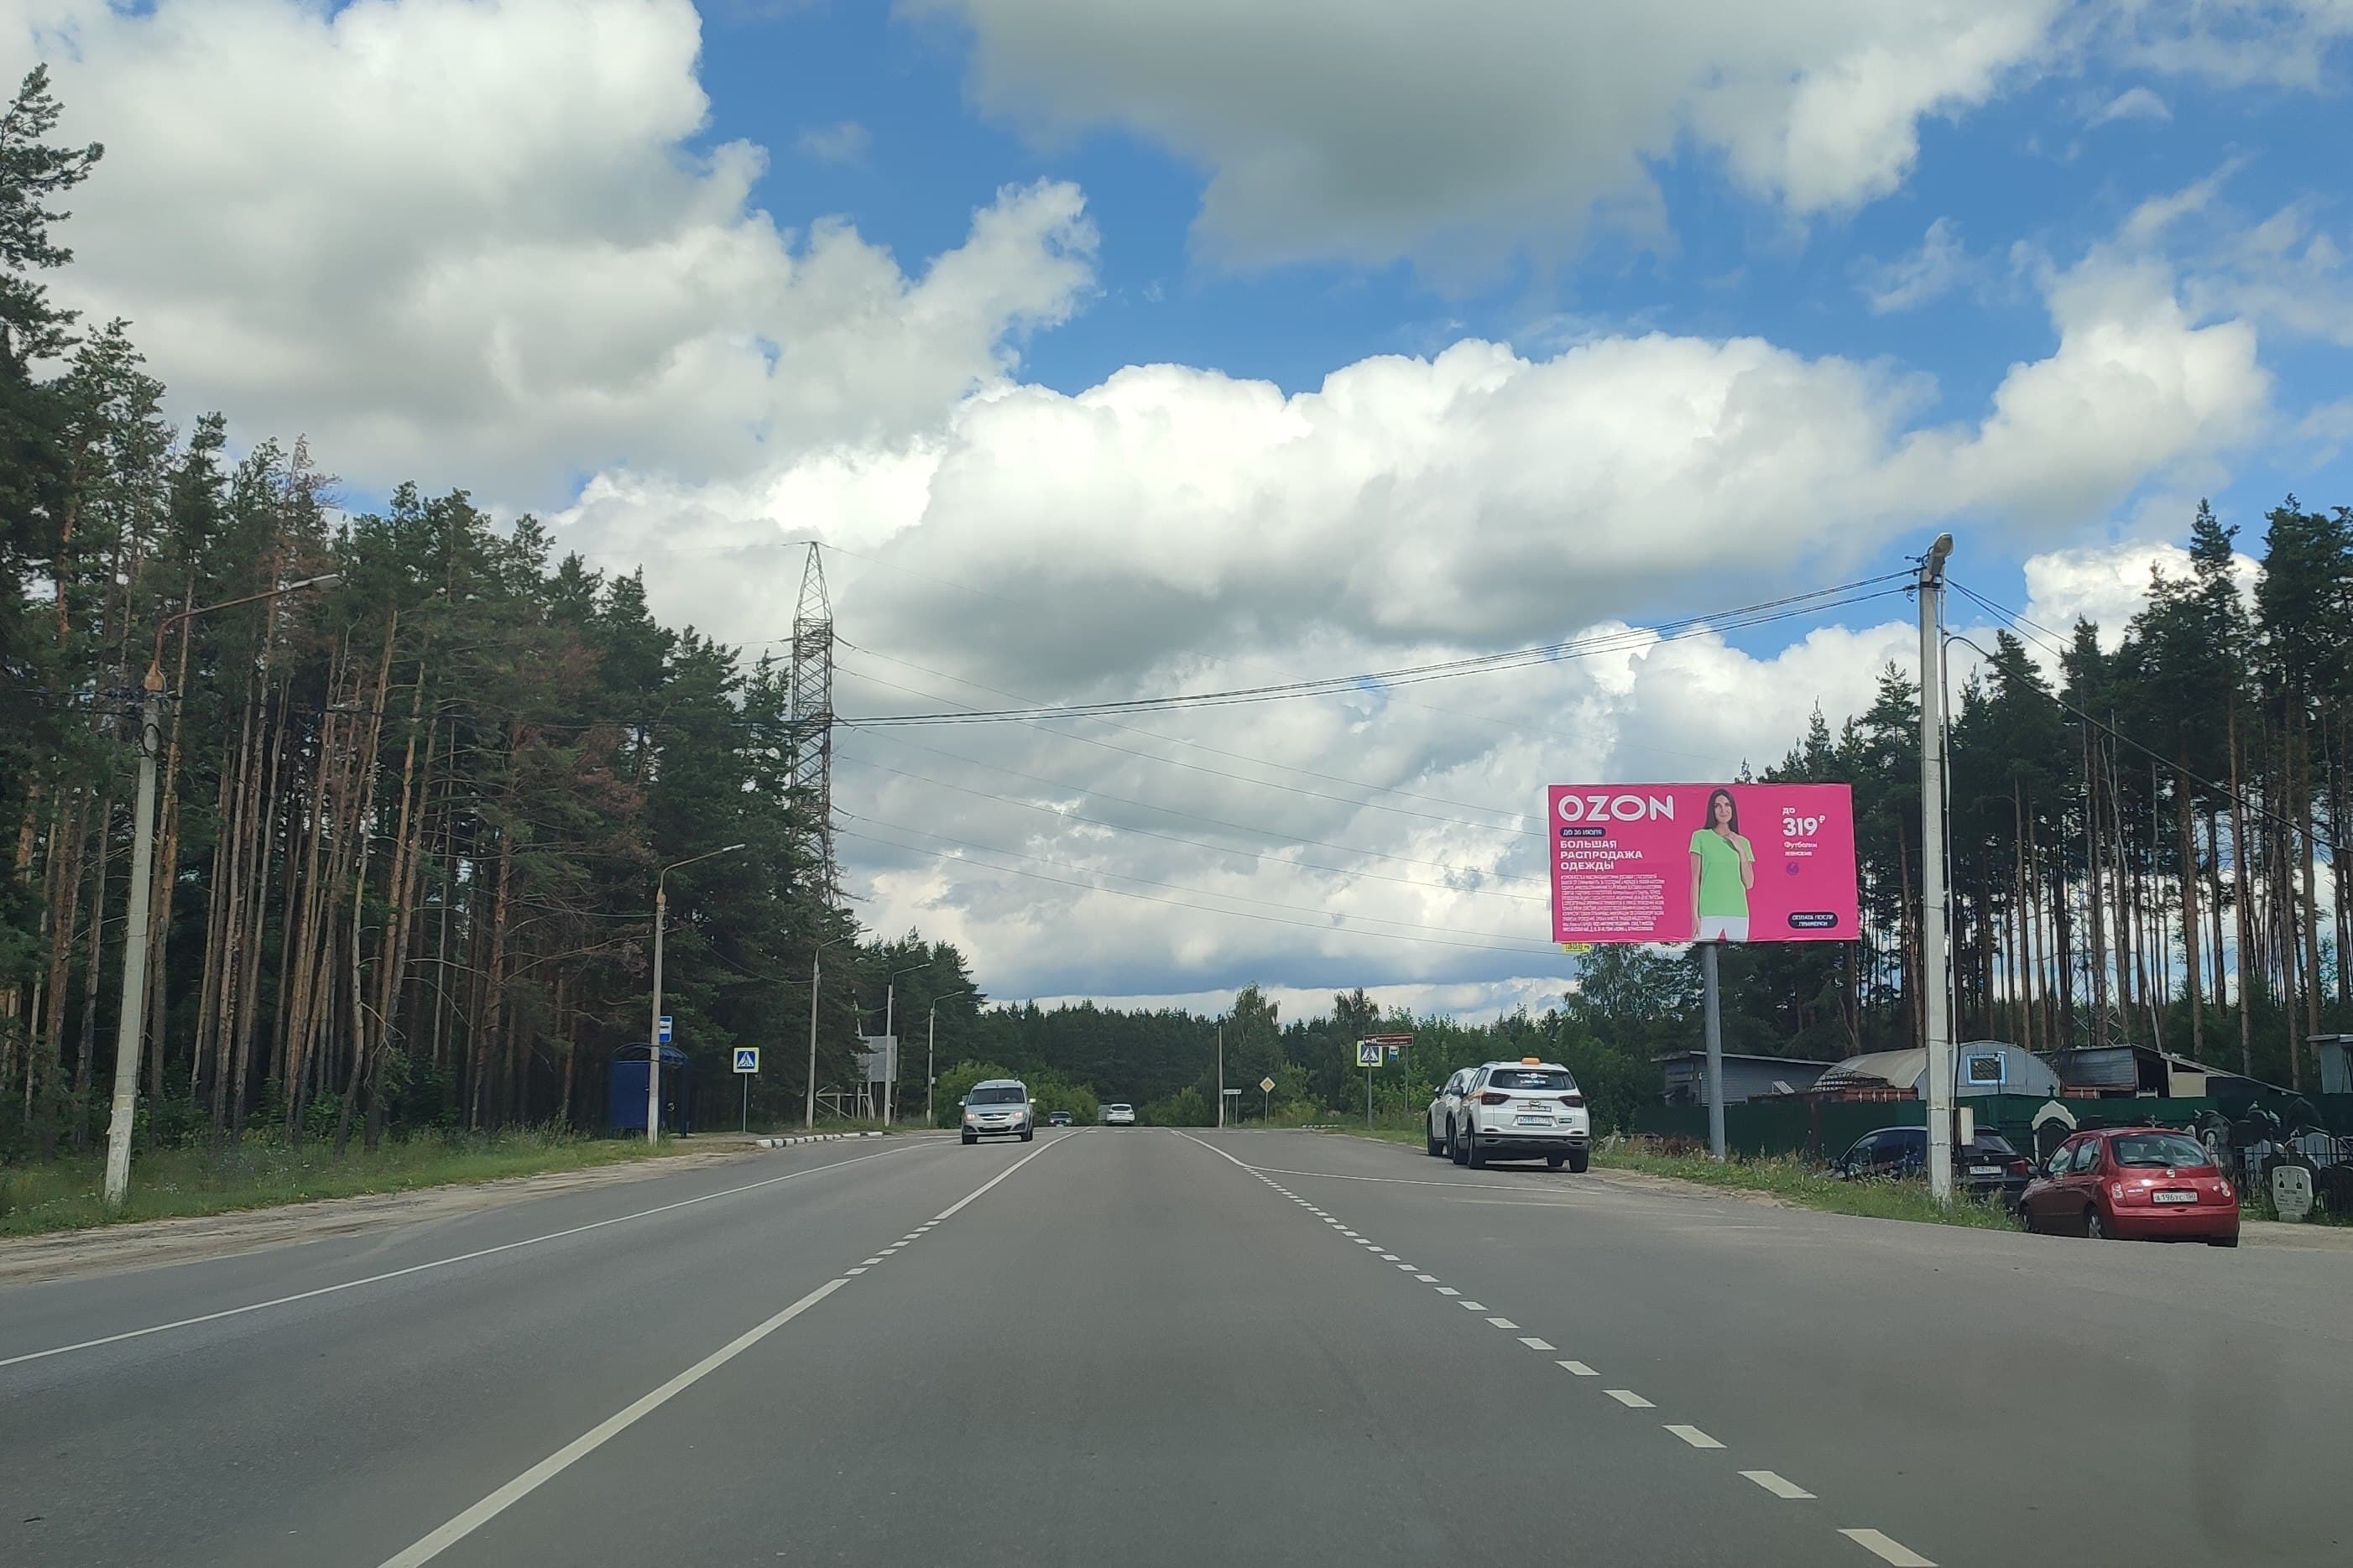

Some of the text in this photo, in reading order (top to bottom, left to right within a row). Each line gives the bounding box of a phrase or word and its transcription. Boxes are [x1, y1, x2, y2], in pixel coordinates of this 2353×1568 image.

[1558, 794, 1674, 821] OZON
[1560, 840, 1617, 849] БОЛЬШАЯ
[1560, 851, 1643, 860] РАСПРОДАЖА
[1560, 861, 1615, 873] ОДЕЖДЫ
